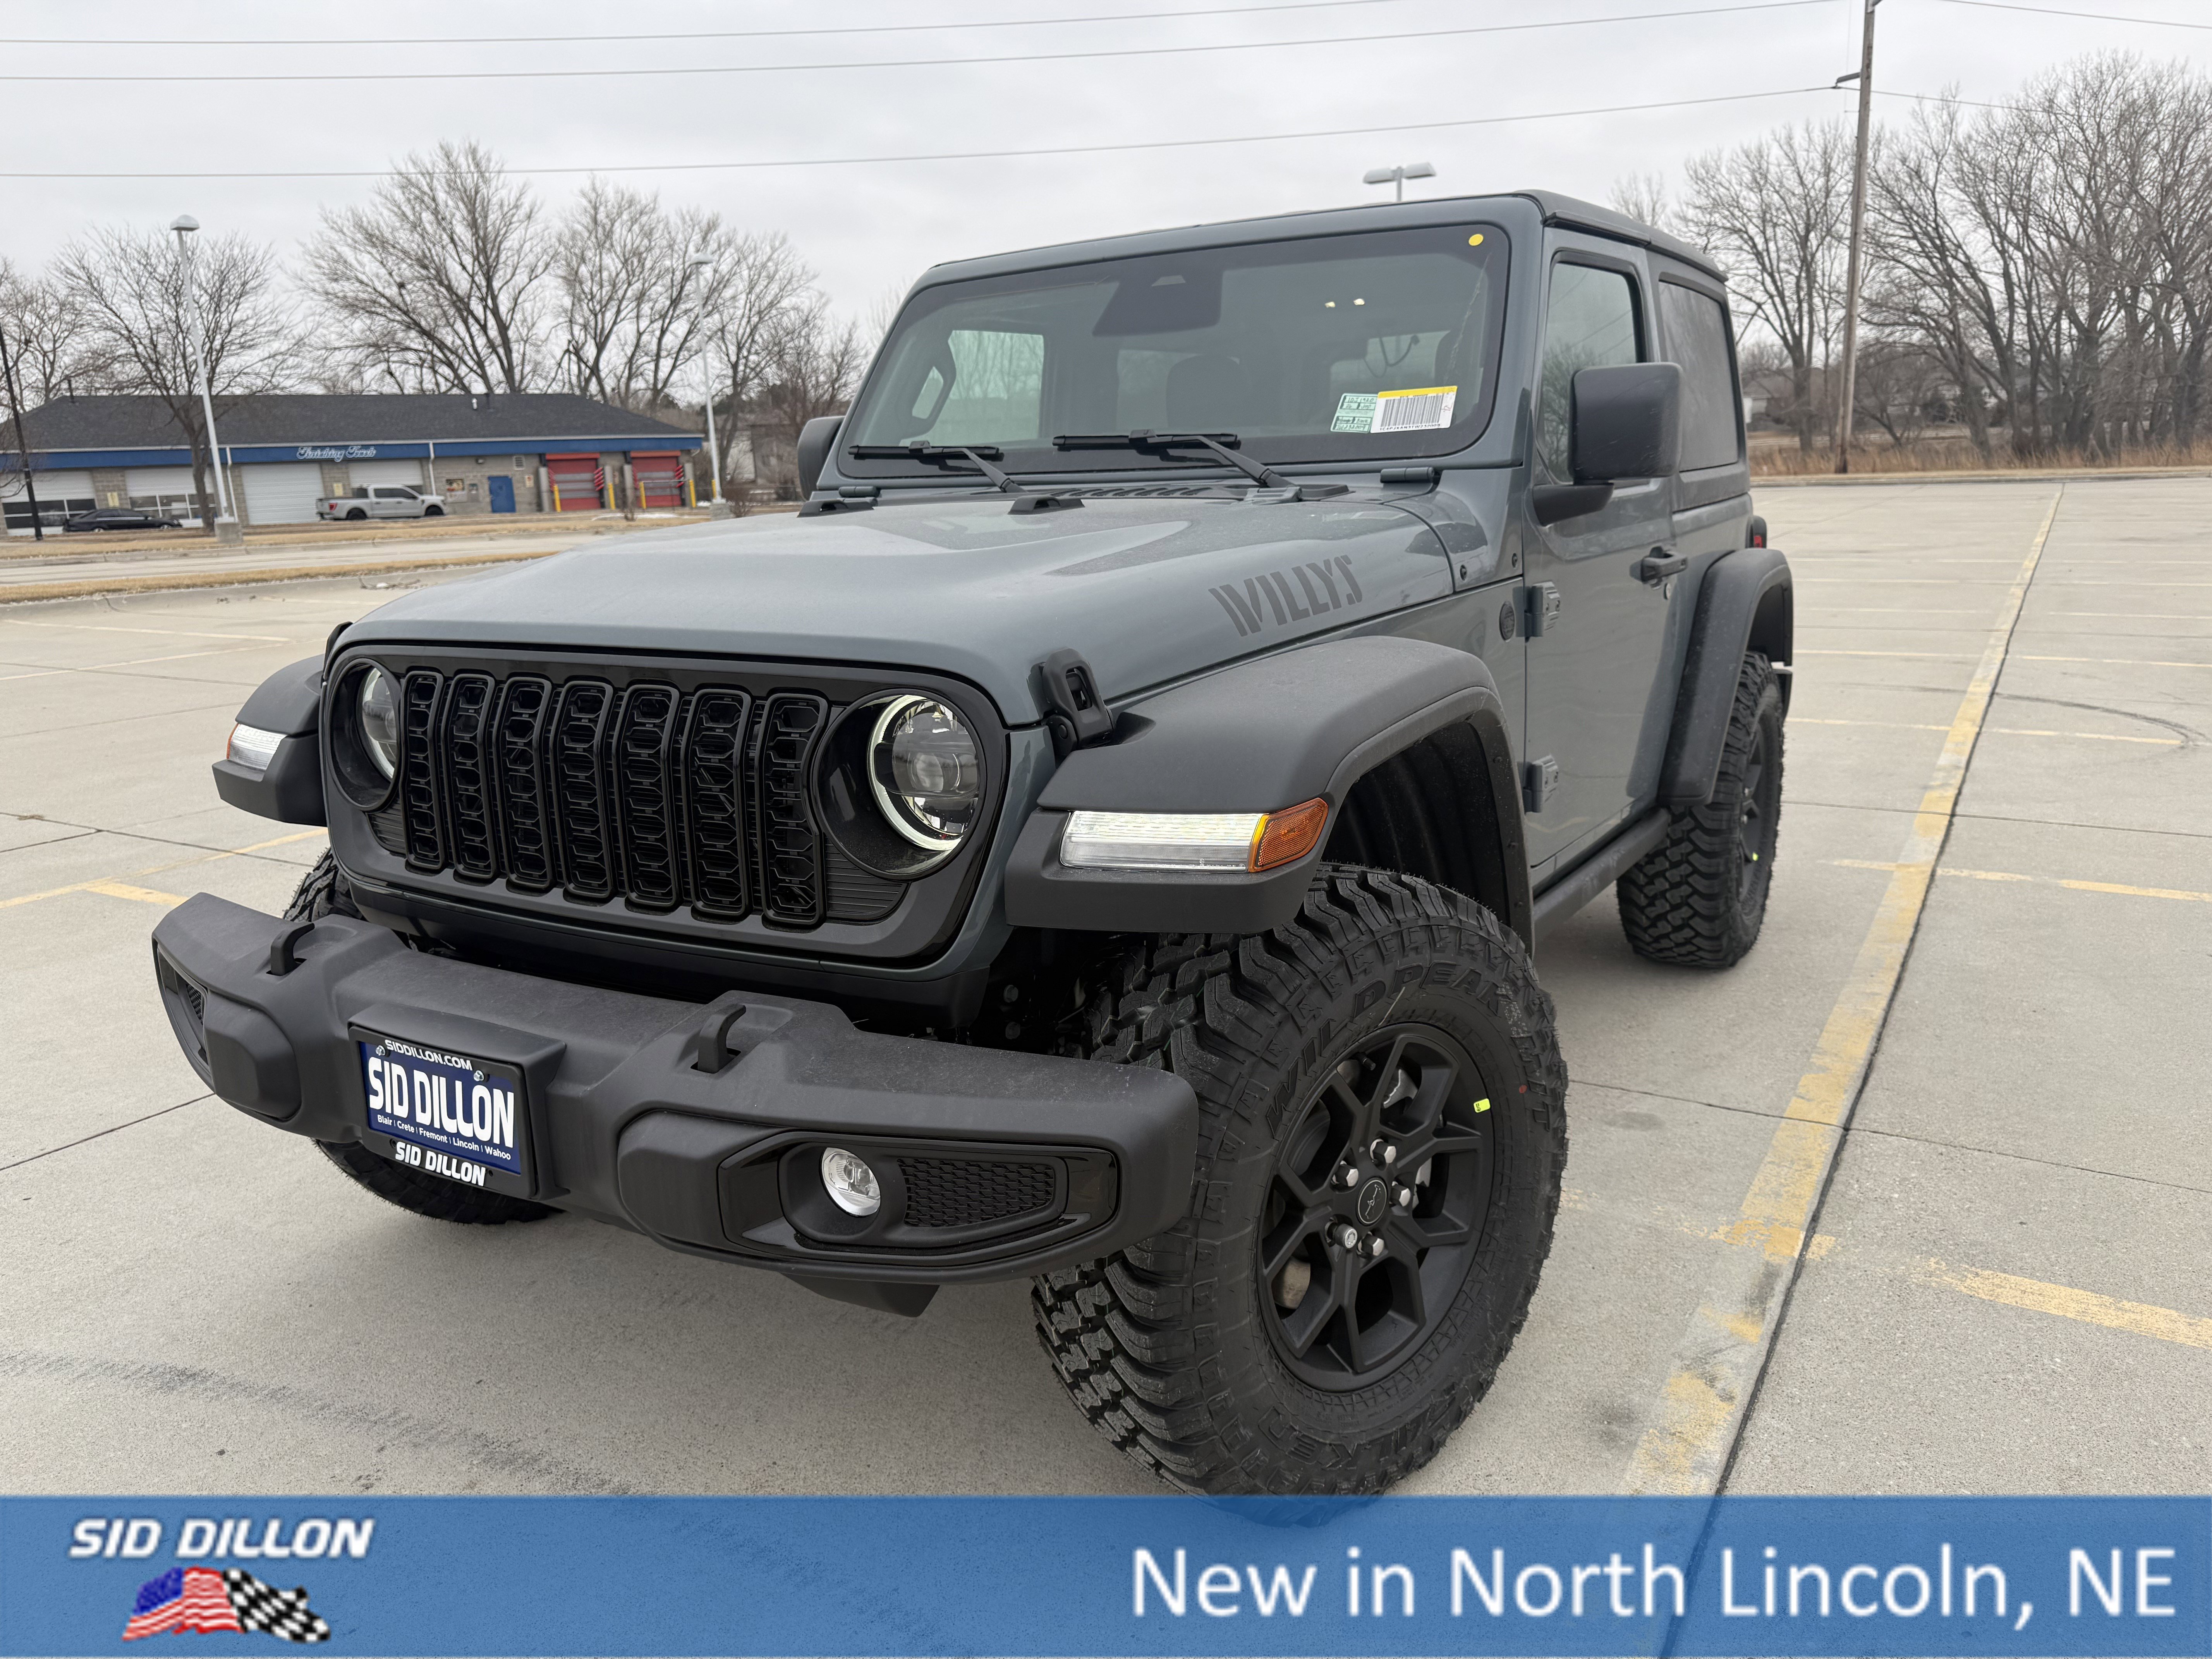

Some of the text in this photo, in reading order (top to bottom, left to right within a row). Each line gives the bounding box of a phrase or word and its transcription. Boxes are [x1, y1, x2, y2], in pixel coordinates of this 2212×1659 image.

[1208, 555, 1363, 637] WILLYS
[384, 1039, 473, 1071] SIDDILLON.COM
[368, 1056, 514, 1148] SID DILLON
[377, 1115, 511, 1161] Blair Crete Fremont Lincoln Wahoo
[395, 1142, 486, 1186] SID DILLON
